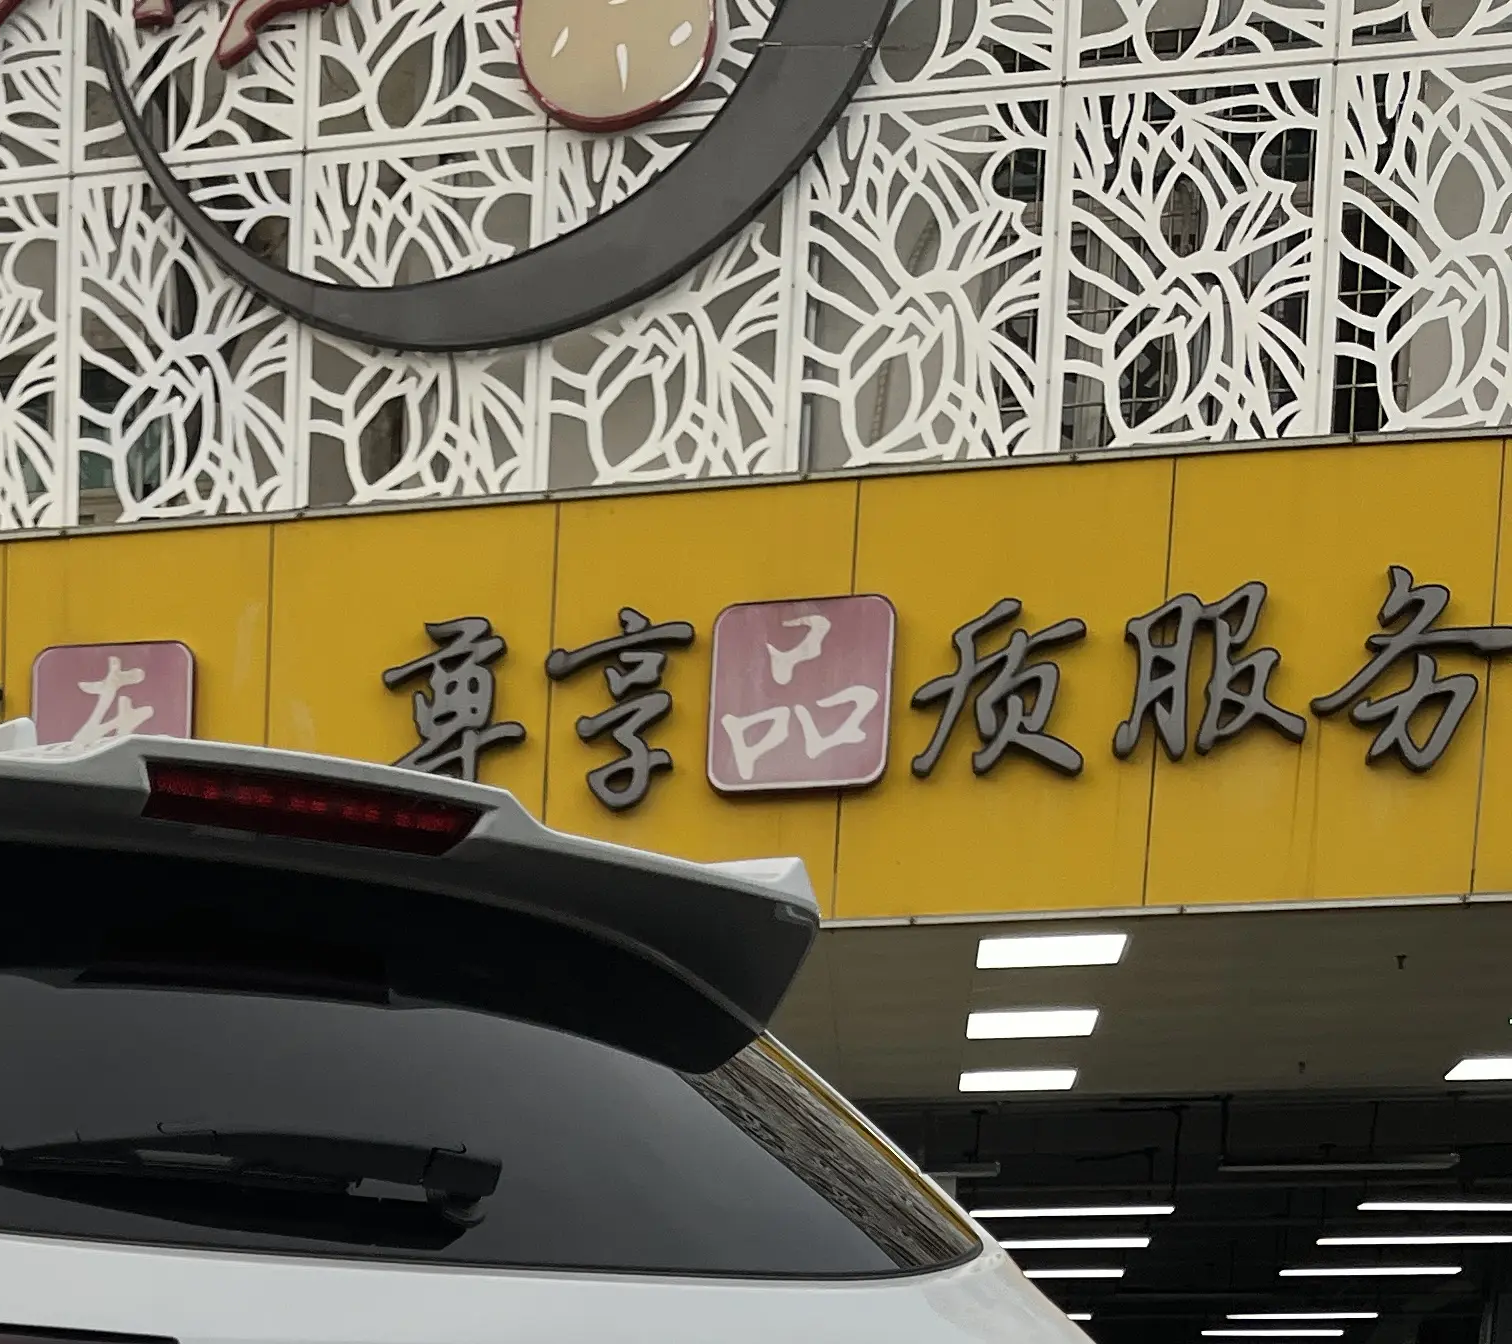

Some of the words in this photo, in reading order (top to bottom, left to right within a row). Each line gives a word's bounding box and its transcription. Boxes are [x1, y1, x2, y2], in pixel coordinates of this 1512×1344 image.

[383, 565, 1512, 812] 尊享品质服务
